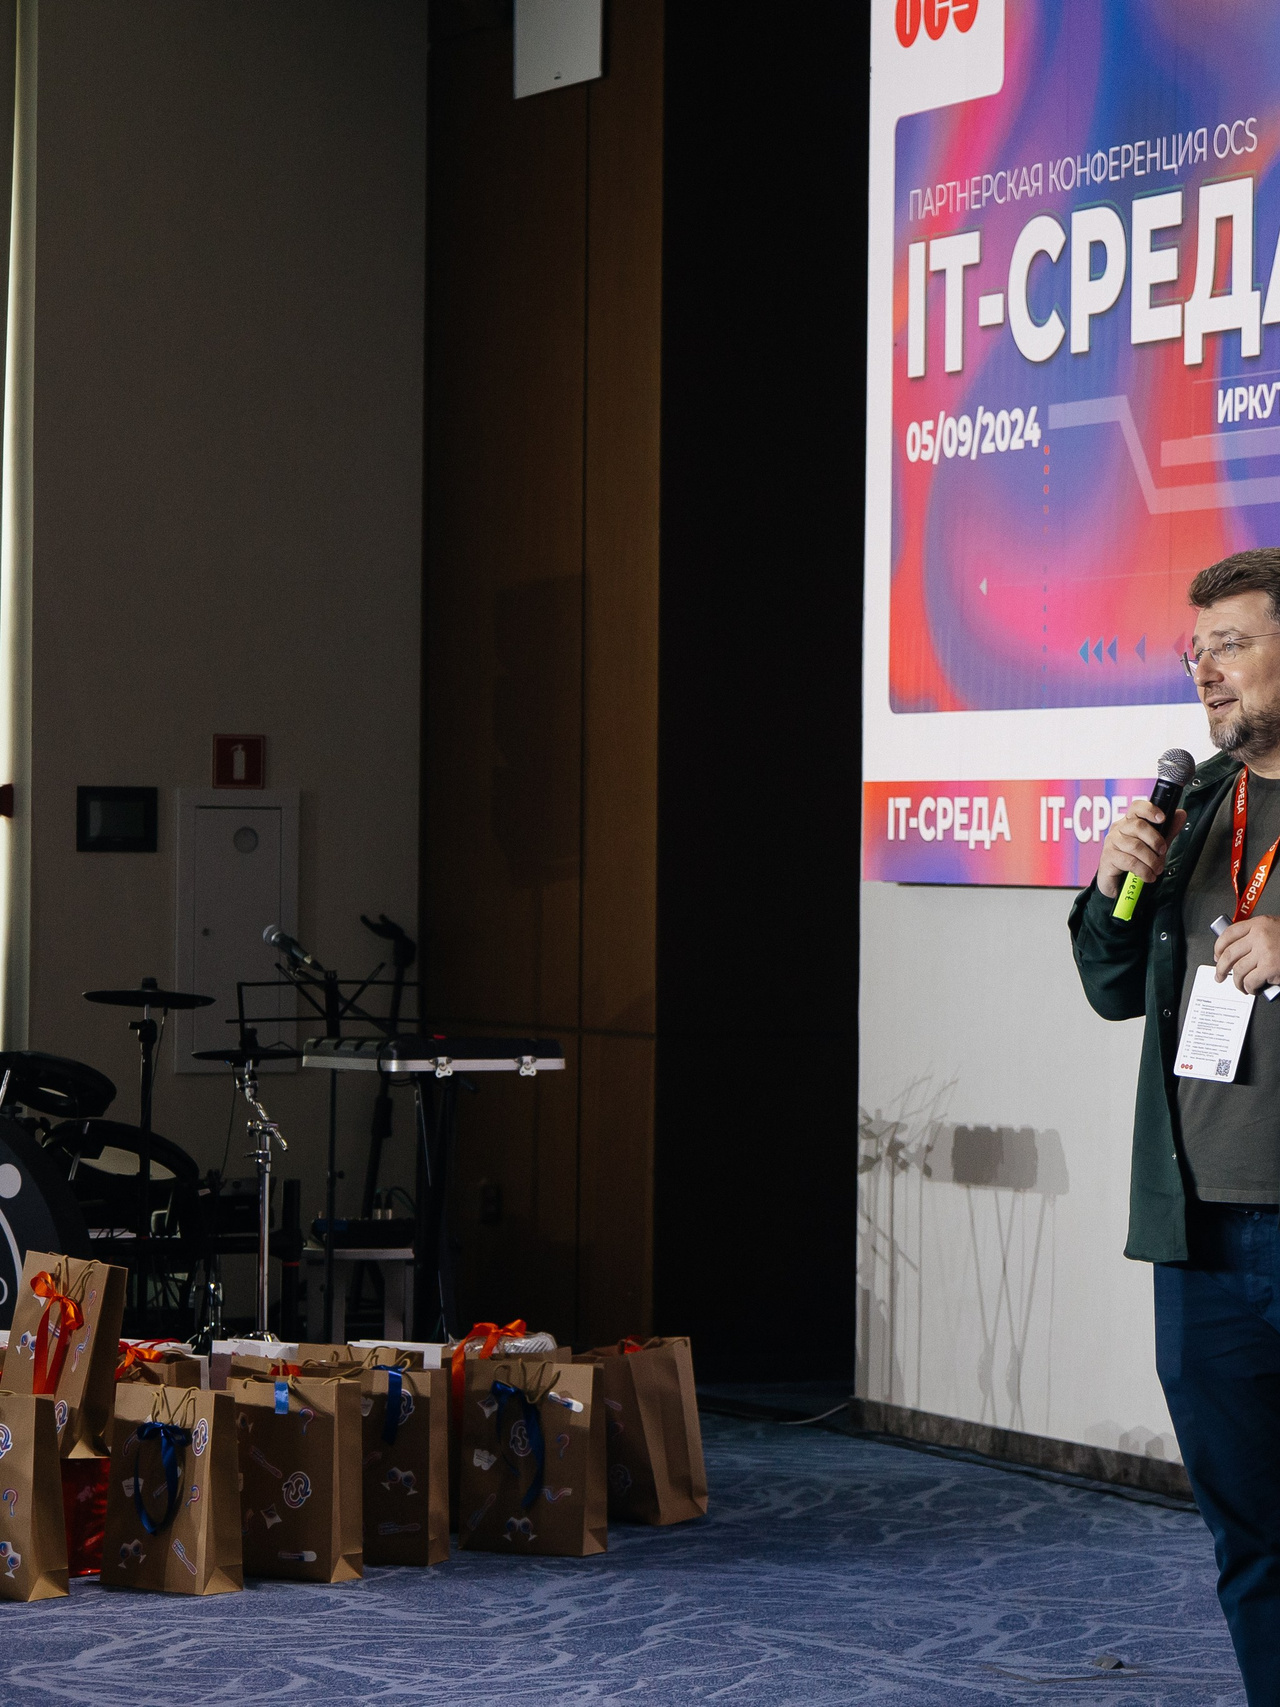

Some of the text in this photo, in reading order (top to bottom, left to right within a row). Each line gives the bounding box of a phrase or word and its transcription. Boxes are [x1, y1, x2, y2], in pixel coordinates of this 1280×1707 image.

[909, 117, 1258, 221] ПАРТНЕРСКАЯ КОНФЕРЕНЦИЯ OCS
[906, 405, 1042, 464] 05/09/2024
[887, 796, 1012, 850] IT-СРЕДА
[1125, 875, 1138, 901] uest
[1240, 864, 1267, 914] IT-СРЕДА
